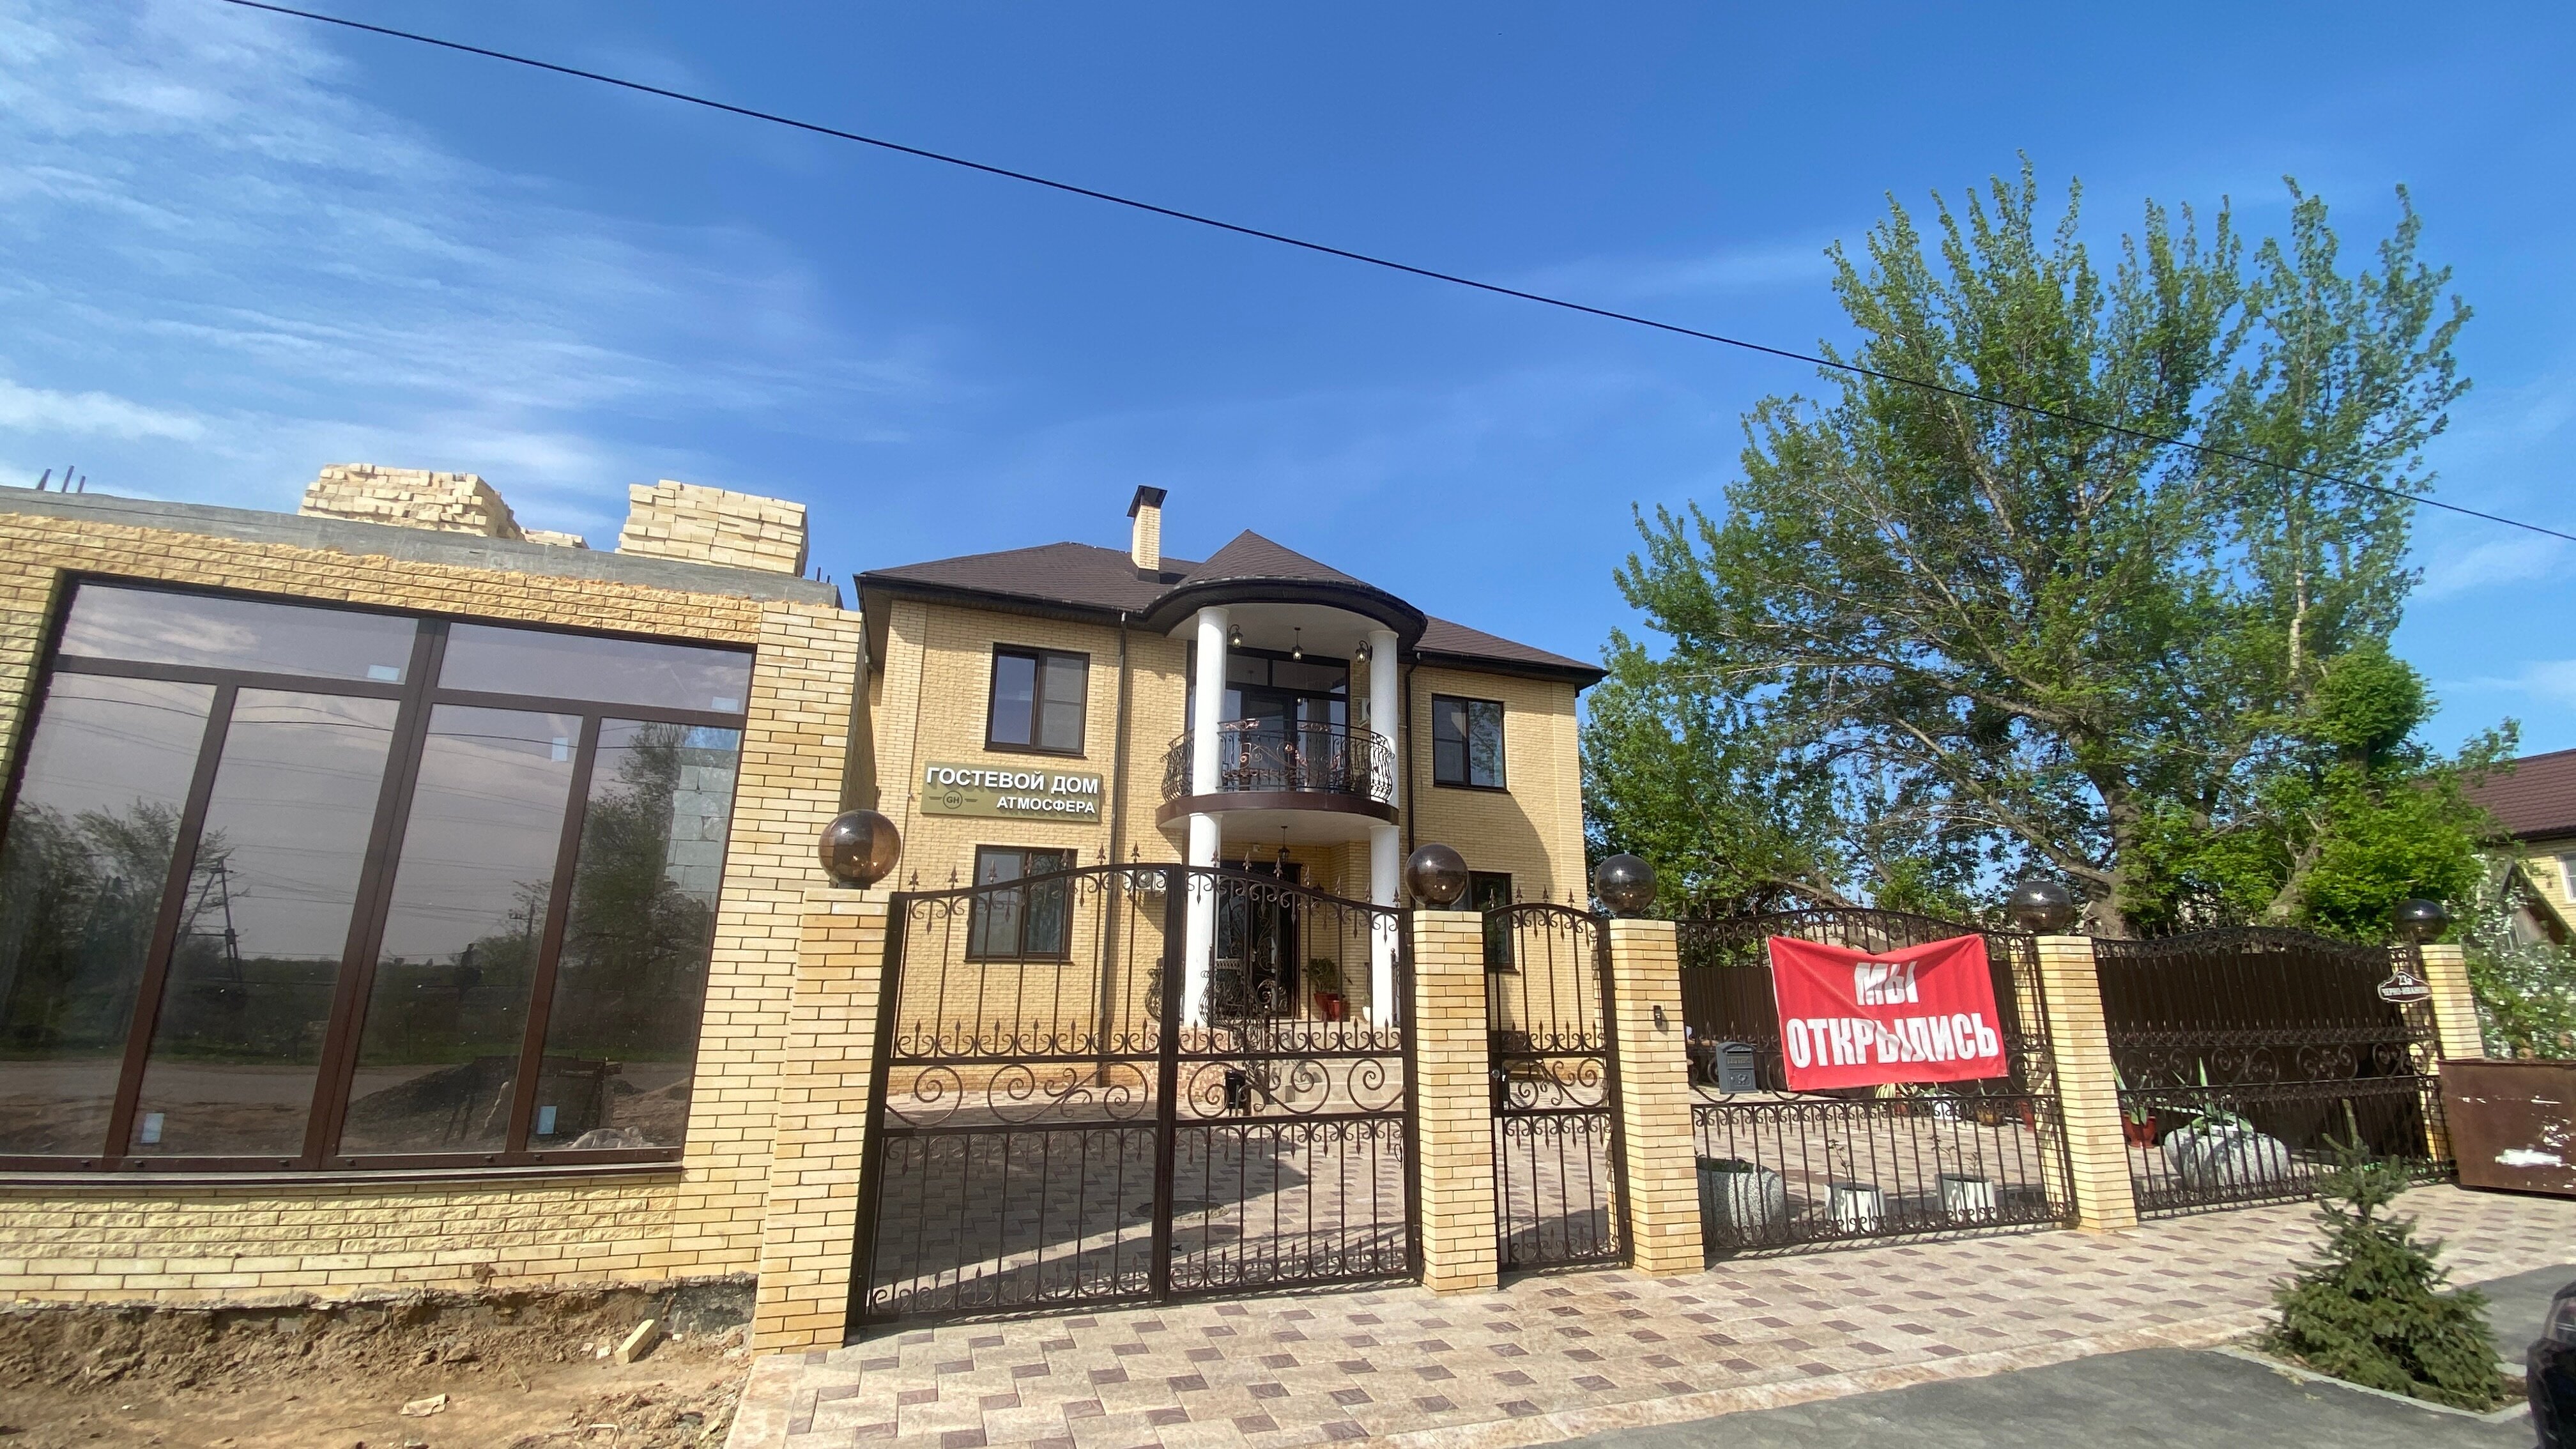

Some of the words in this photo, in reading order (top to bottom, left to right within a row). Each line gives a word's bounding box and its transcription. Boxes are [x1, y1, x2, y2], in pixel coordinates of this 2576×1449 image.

[926, 767, 1045, 790] ГОСТЕВОЙ
[1051, 776, 1098, 795] ДОМ
[996, 796, 1096, 813] АТМОСФЕРА
[1854, 960, 1919, 1006] МЫ
[1786, 1013, 2000, 1068] ОТКРЫЛИСЬ
